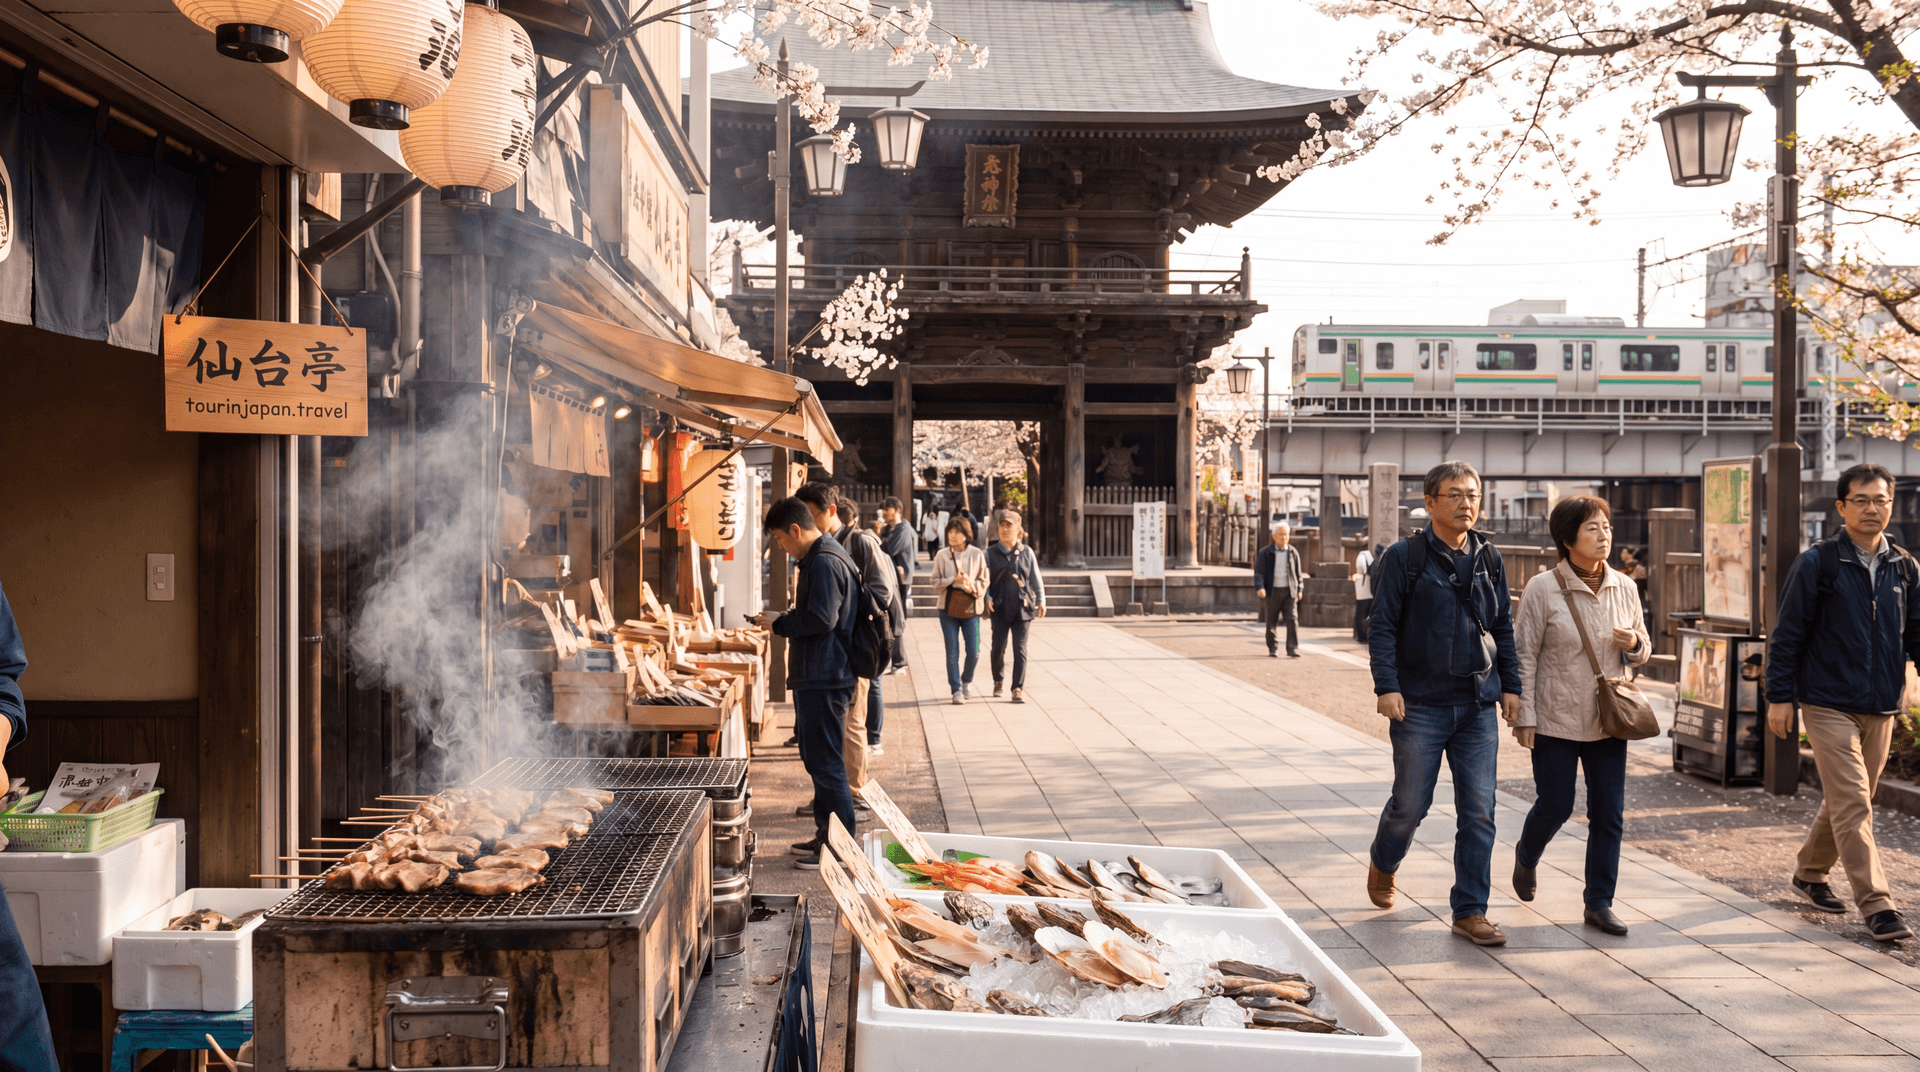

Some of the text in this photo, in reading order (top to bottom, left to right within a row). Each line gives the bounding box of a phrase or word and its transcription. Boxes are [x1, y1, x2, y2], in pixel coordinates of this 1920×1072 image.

[187, 337, 346, 393] 仙台亭
[185, 397, 348, 420] tourinjapan.travel
